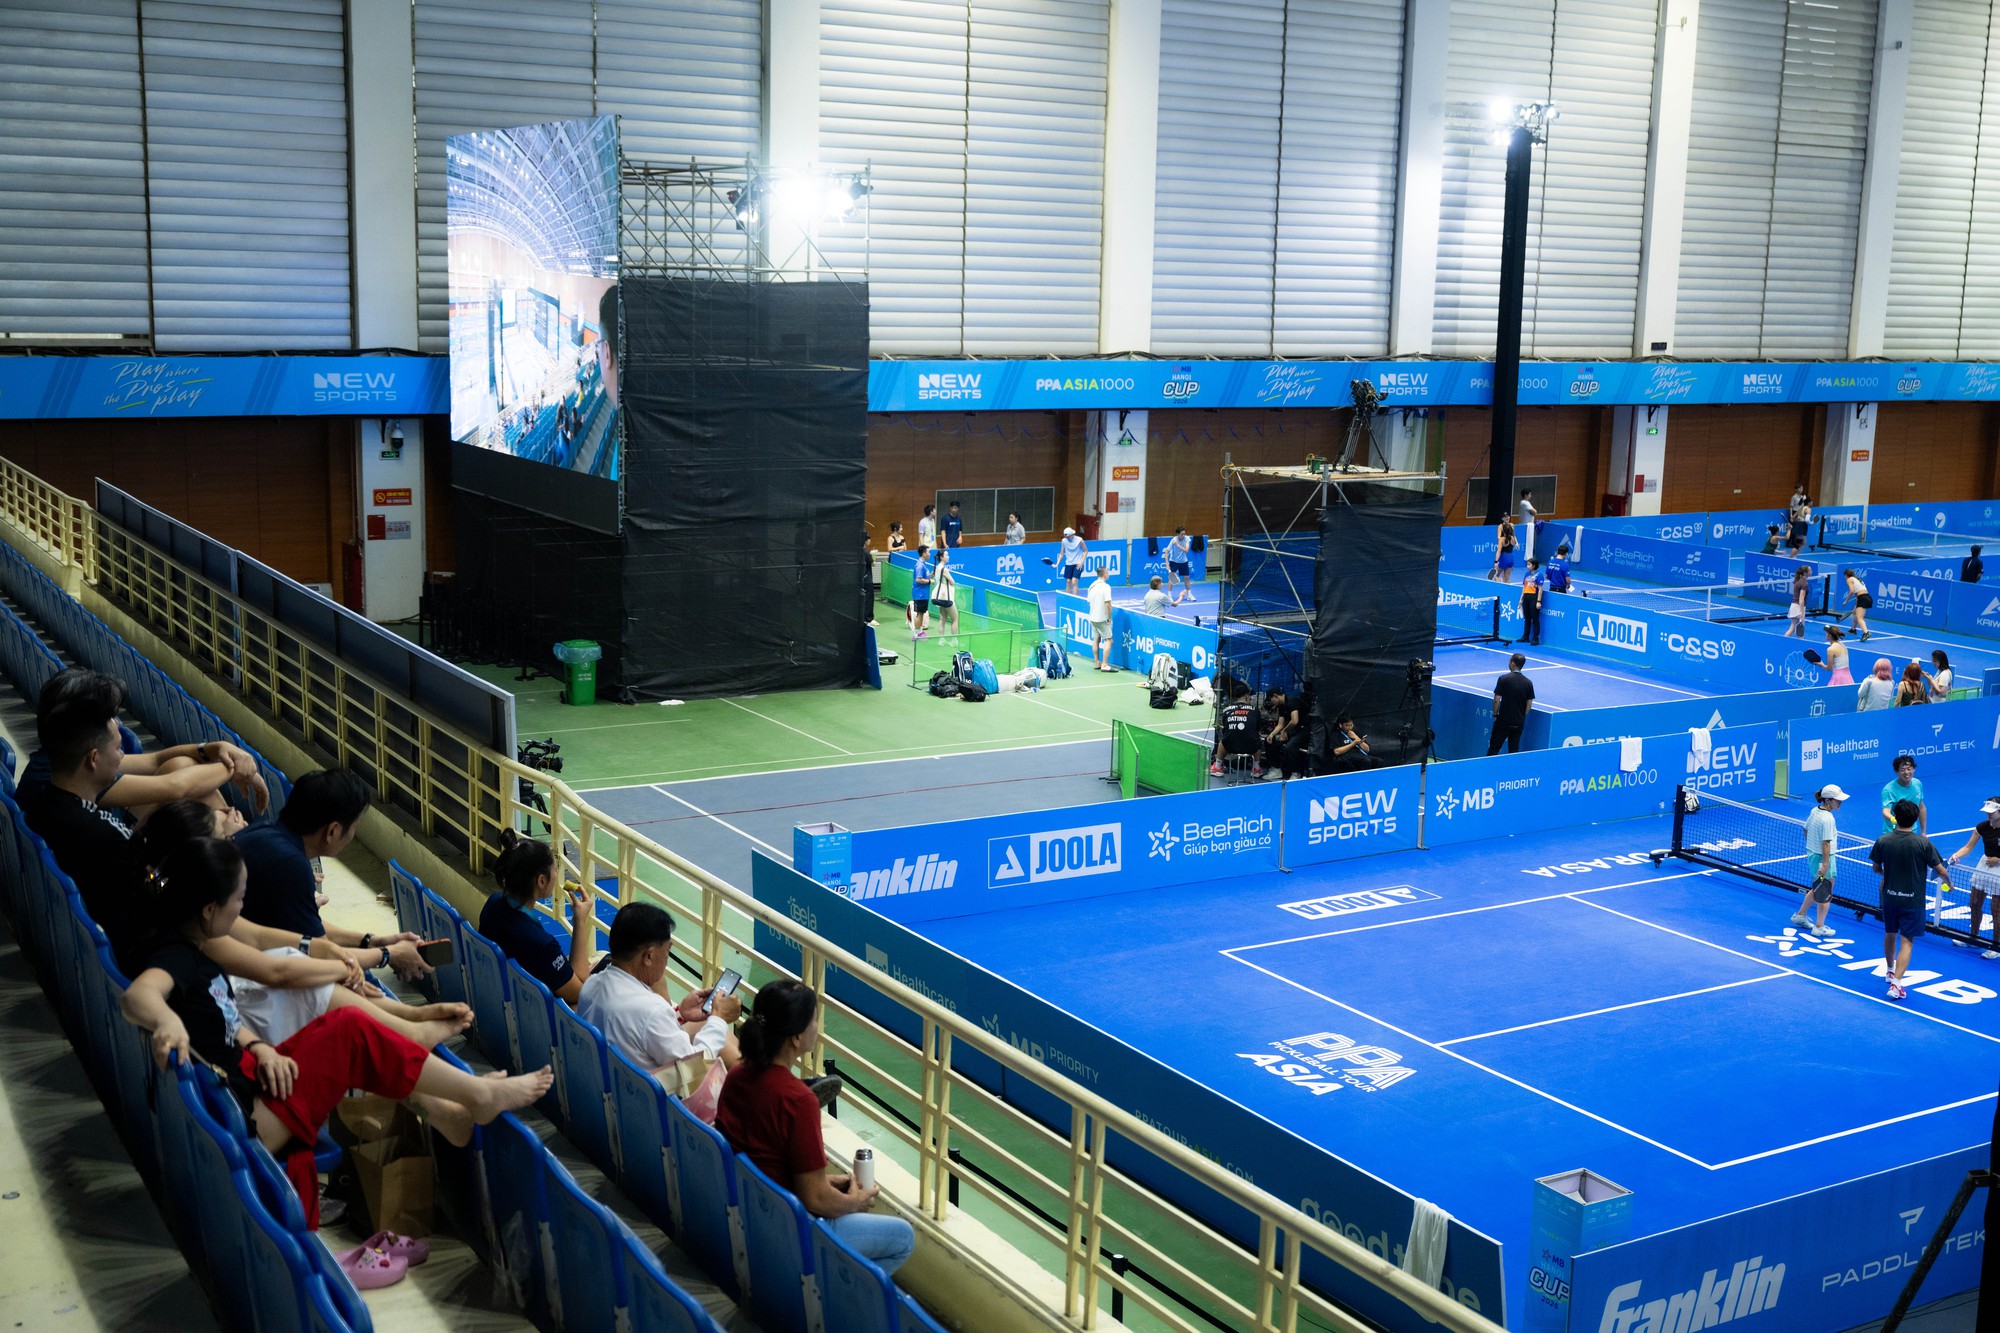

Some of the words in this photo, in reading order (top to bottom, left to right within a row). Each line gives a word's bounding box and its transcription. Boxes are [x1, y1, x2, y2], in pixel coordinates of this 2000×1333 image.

[110, 361, 167, 384] Play
[314, 373, 395, 388] NEW
[918, 374, 981, 388] NEW
[1263, 365, 1296, 381] Play
[1380, 373, 1428, 386] NEW
[1650, 365, 1678, 380] Play
[1743, 374, 1782, 385] NEW
[119, 380, 175, 402] Pros
[918, 389, 981, 399] SPORTS
[1162, 381, 1200, 398] CUP
[1267, 378, 1300, 395] Pros
[1283, 384, 1316, 405] play
[1570, 381, 1599, 396] CUP
[1665, 384, 1692, 401] play
[1743, 386, 1782, 394] SPORTS
[1897, 379, 1921, 393] CUP
[150, 388, 203, 414] play
[314, 391, 396, 401] SPORTS
[1661, 525, 1693, 539] C&S
[1724, 525, 1738, 535] FPT
[1739, 524, 1755, 536] Play
[997, 553, 1024, 571] PPA
[1614, 548, 1654, 562] BeeRich
[1000, 576, 1021, 585] ASIA
[1878, 582, 1934, 603] NEW
[1877, 599, 1932, 616] SPORTS
[1601, 619, 1644, 647] JOOLA
[1136, 635, 1154, 654] MB
[1155, 637, 1180, 650] PRIORITY
[1668, 633, 1719, 659] C&S
[1804, 750, 1818, 760] SBB
[1826, 739, 1879, 754] Healthcare
[1899, 740, 1976, 757] PADDLETEK
[1853, 751, 1879, 761] Premium
[1499, 777, 1540, 792] PRIORITY
[1685, 768, 1756, 790] SPORTS
[1309, 788, 1397, 824] NEW
[1462, 788, 1494, 812] MB
[1184, 814, 1272, 842] BeeRich
[1308, 816, 1397, 844] SPORTS
[1036, 832, 1117, 875] JOOLA
[1183, 843, 1208, 856] Giúp
[1211, 841, 1231, 855] bạn
[1234, 837, 1256, 852] giàu
[1259, 834, 1271, 846] có
[850, 853, 958, 900] anklin
[1050, 1047, 1099, 1084] PRIORITY
[1268, 1041, 1339, 1076] PICKLEBALL
[1338, 1074, 1377, 1093] TOUR
[1282, 1031, 1417, 1090] PPA
[1235, 1053, 1344, 1096] ASIA
[1552, 1254, 1565, 1268] MB
[1821, 1229, 1986, 1293] PADDLTEK
[1529, 1267, 1570, 1300] CUP
[1599, 1255, 1786, 1333] Franklin
